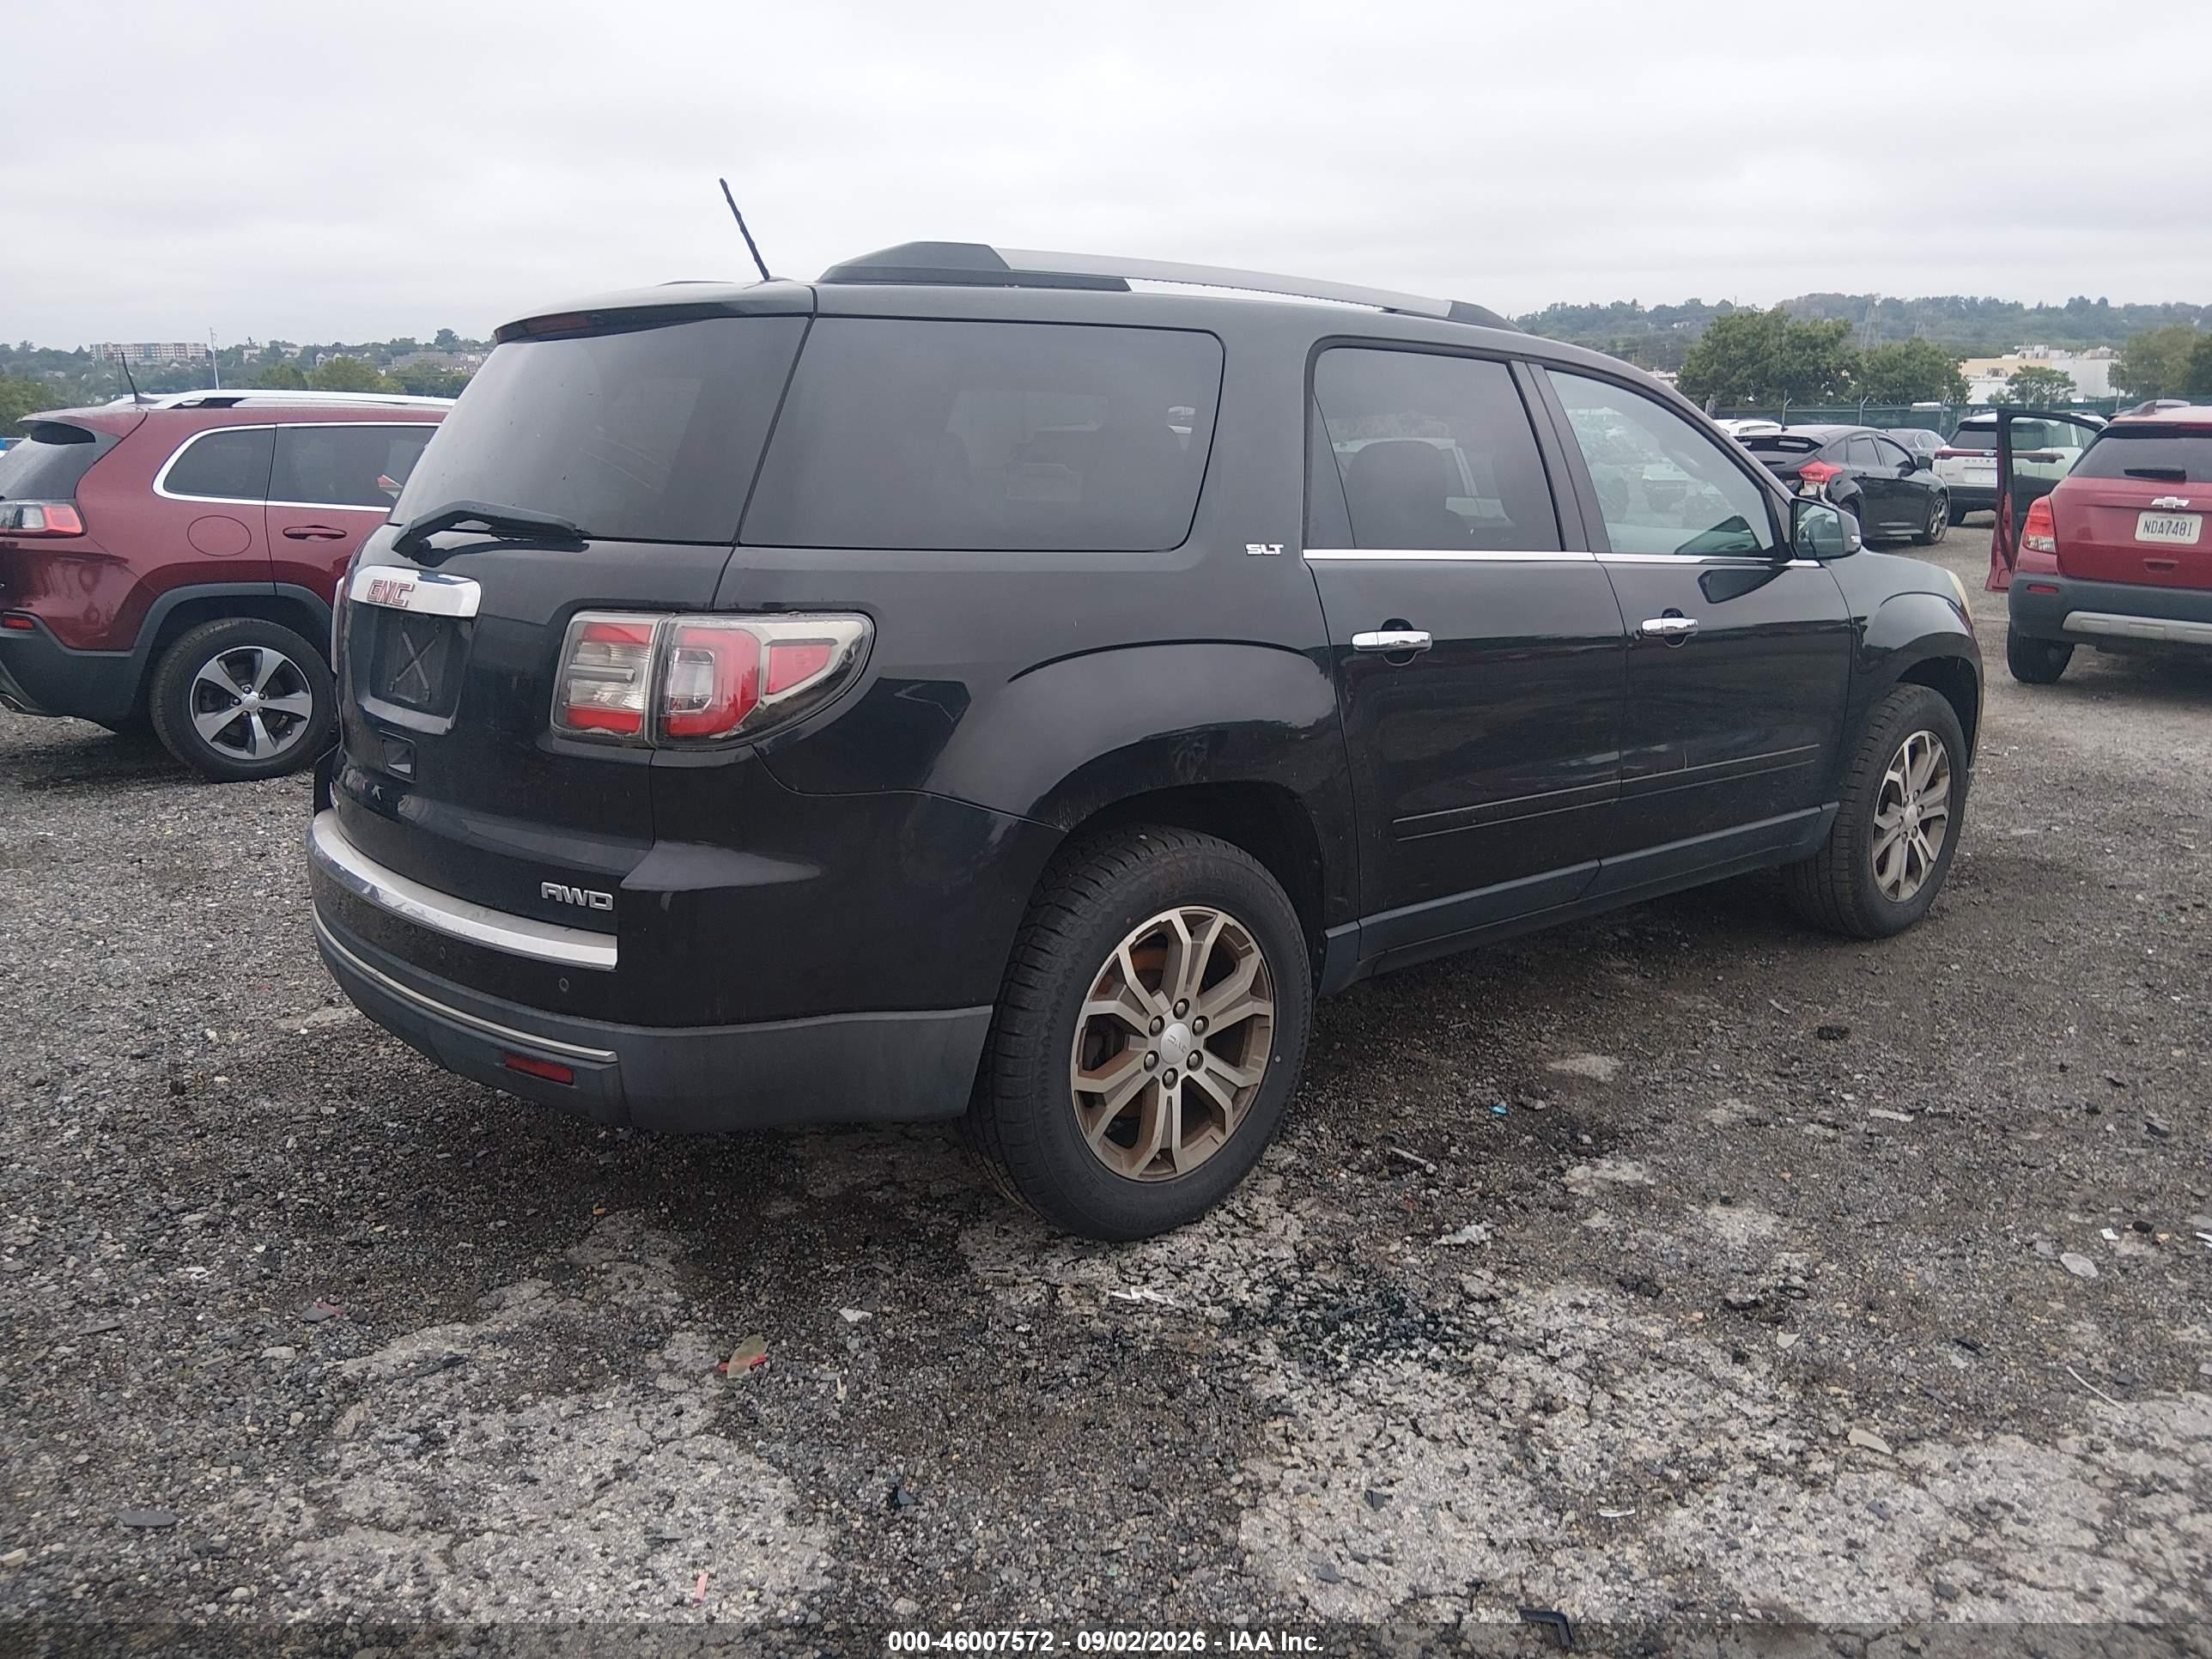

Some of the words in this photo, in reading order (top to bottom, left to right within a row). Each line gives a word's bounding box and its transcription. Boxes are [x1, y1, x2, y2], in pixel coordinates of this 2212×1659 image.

[2142, 520, 2193, 537] NDA7481
[1245, 543, 1285, 555] SLT
[367, 579, 416, 607] GMC
[541, 881, 613, 910] AWD
